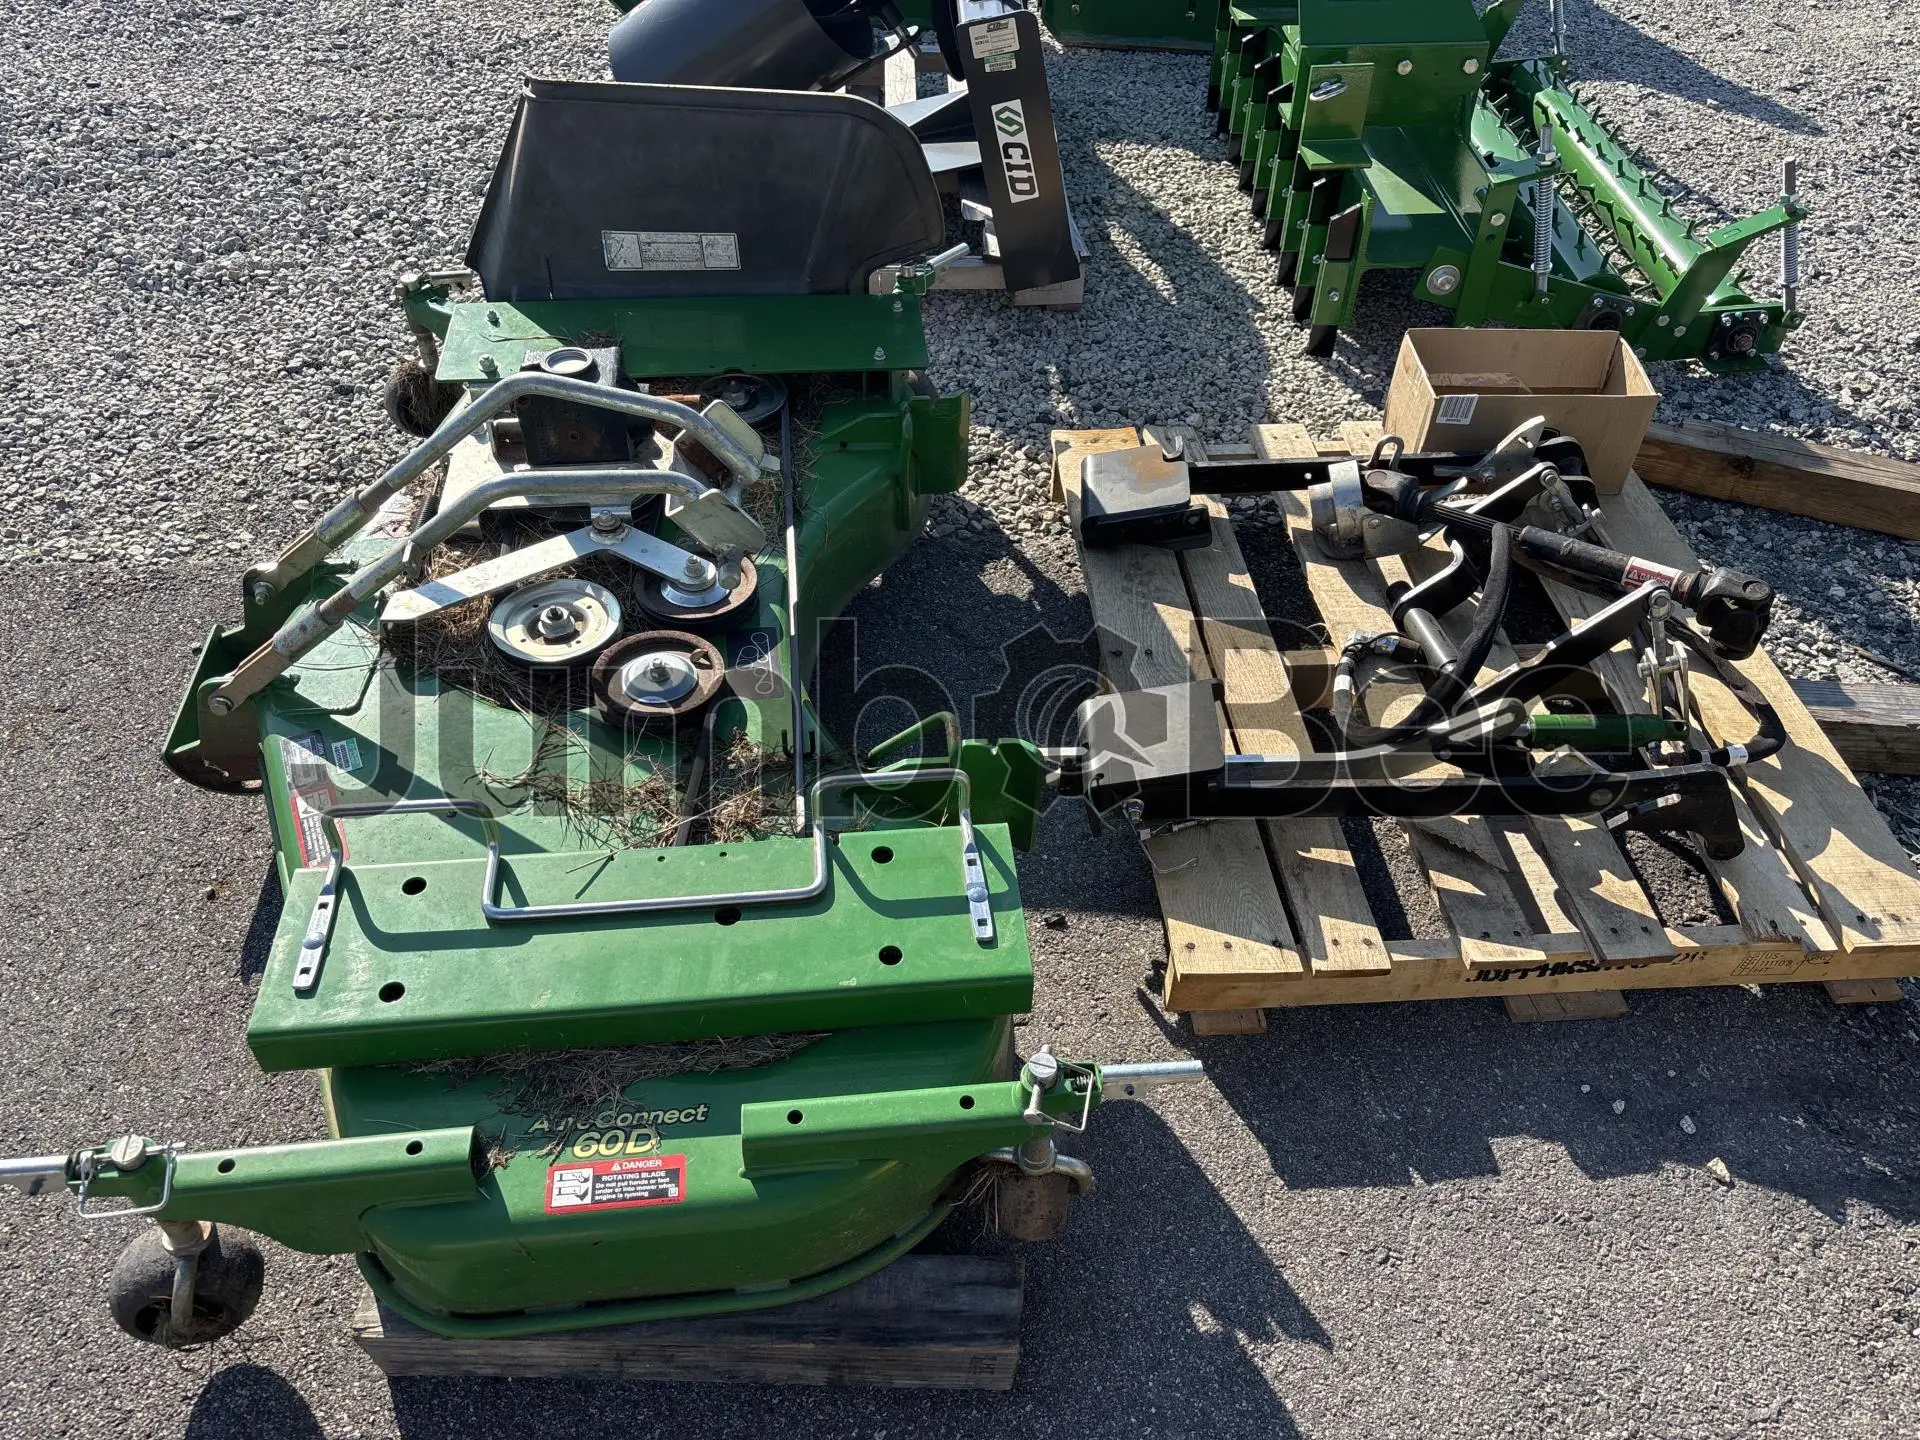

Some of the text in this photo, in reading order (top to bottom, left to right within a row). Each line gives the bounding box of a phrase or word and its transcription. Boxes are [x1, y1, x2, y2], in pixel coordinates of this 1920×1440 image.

[1002, 142, 1036, 196] CID
[572, 1127, 656, 1158] 60D
[622, 1159, 662, 1169] DANGER
[602, 1170, 666, 1182] ROTATING BLADE
[618, 1180, 628, 1188] put
[624, 1191, 648, 1200] running
